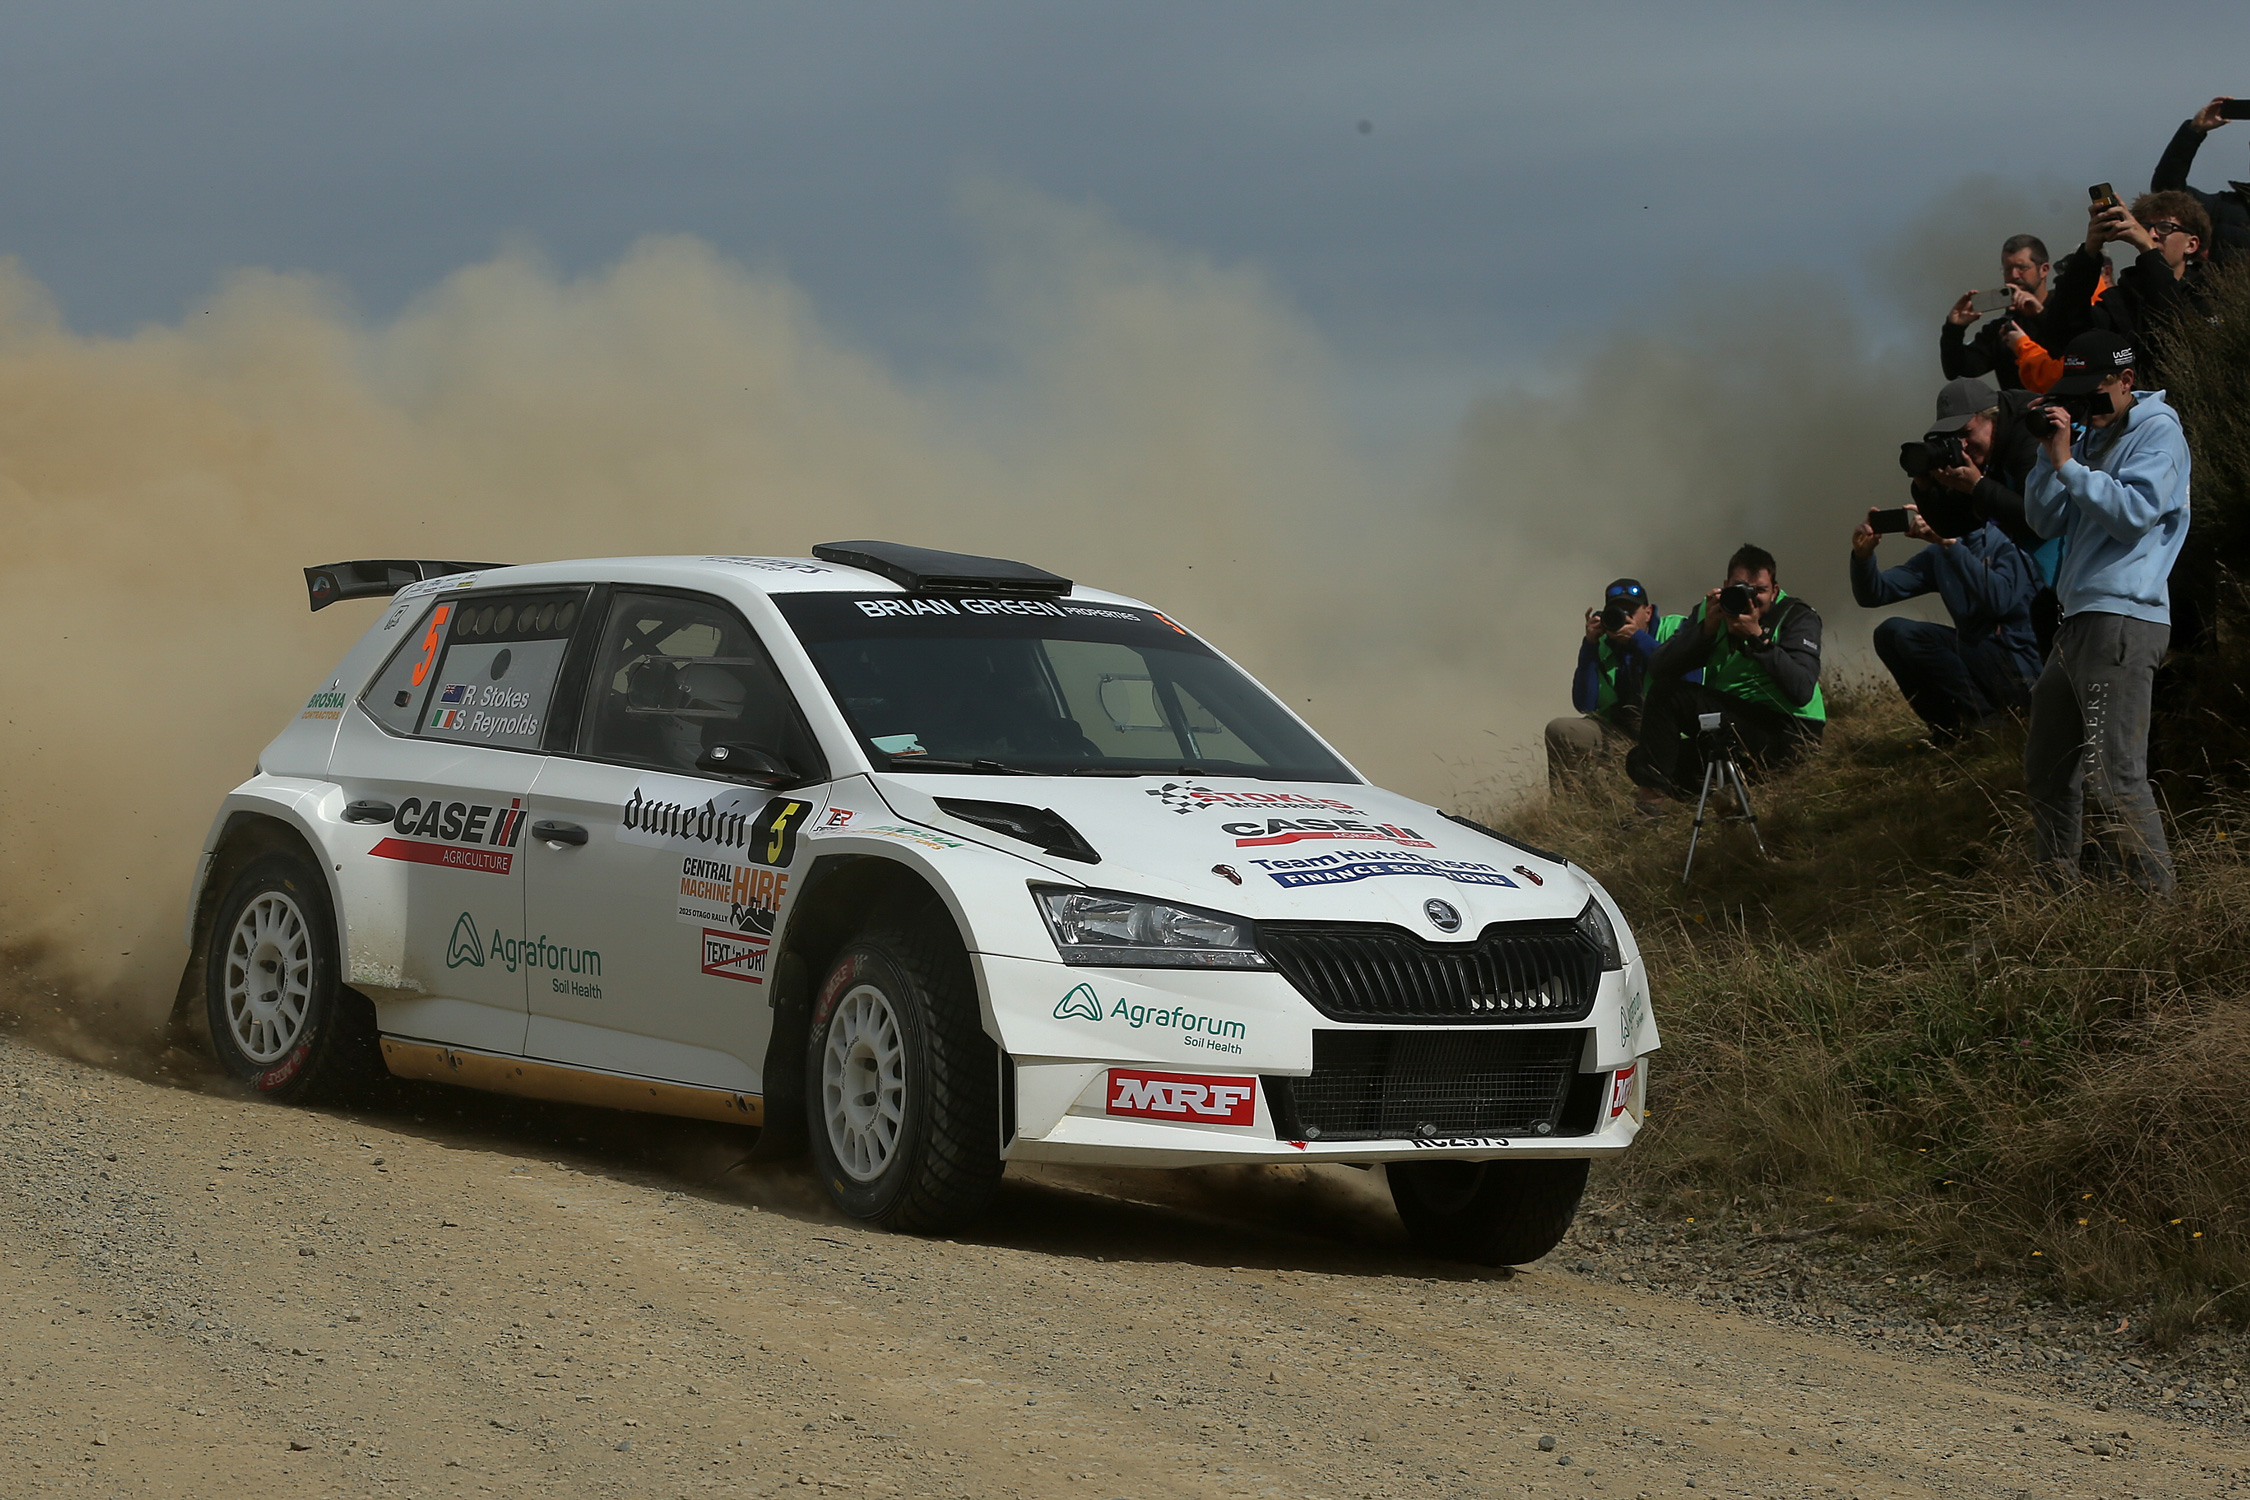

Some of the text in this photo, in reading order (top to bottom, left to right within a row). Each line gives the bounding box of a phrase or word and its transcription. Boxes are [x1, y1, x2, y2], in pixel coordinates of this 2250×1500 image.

[855, 599, 1141, 621] BRIAN GREEN PROPERTIES
[412, 606, 450, 687] 5
[307, 693, 347, 708] BROSNA
[462, 685, 530, 708] R. Stokes
[453, 709, 538, 738] S. Reynolds
[394, 797, 493, 844] CASE
[623, 787, 747, 849] dunedin
[1221, 818, 1377, 837] CASE
[767, 802, 801, 864] 5
[442, 849, 509, 871] AGRICULTURE
[683, 857, 732, 883] CENTRAL
[1248, 854, 1340, 871] Team
[1284, 865, 1384, 884] FINANCE
[681, 877, 732, 903] MACHINE
[732, 866, 789, 912] HIRE
[679, 907, 728, 923] 2025 OTAGO RALLY
[490, 929, 601, 977] Agraforum
[707, 941, 731, 965] TEXT
[748, 949, 768, 972] DRI
[552, 978, 602, 1000] Soil Health
[1110, 998, 1246, 1040] Agraforum
[1184, 1035, 1242, 1055] Soil Health
[1111, 1077, 1251, 1116] MRF
